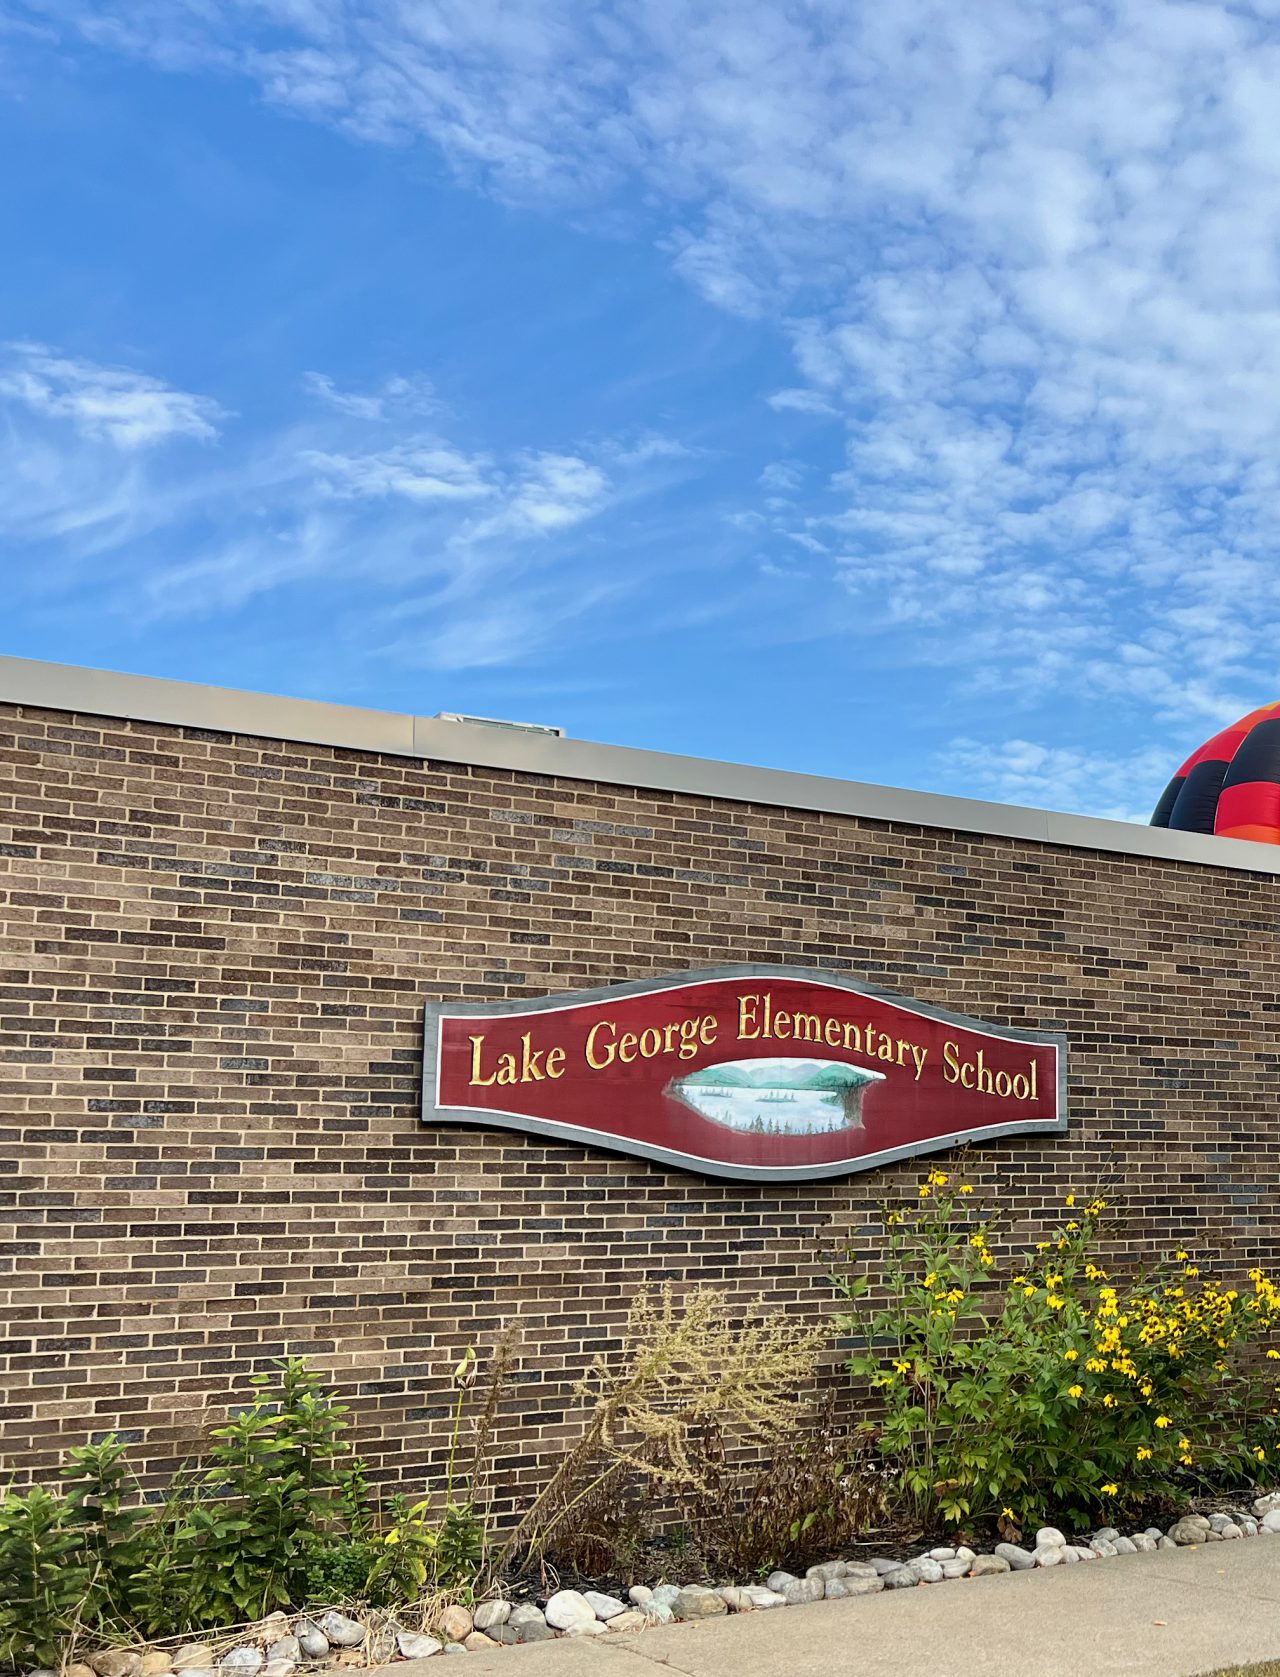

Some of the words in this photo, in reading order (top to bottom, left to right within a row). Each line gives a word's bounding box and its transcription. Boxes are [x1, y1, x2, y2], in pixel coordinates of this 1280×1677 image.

[467, 1031, 566, 1087] Lake
[584, 1014, 719, 1070] George
[735, 993, 929, 1081] Elementary
[942, 1040, 1039, 1101] School
